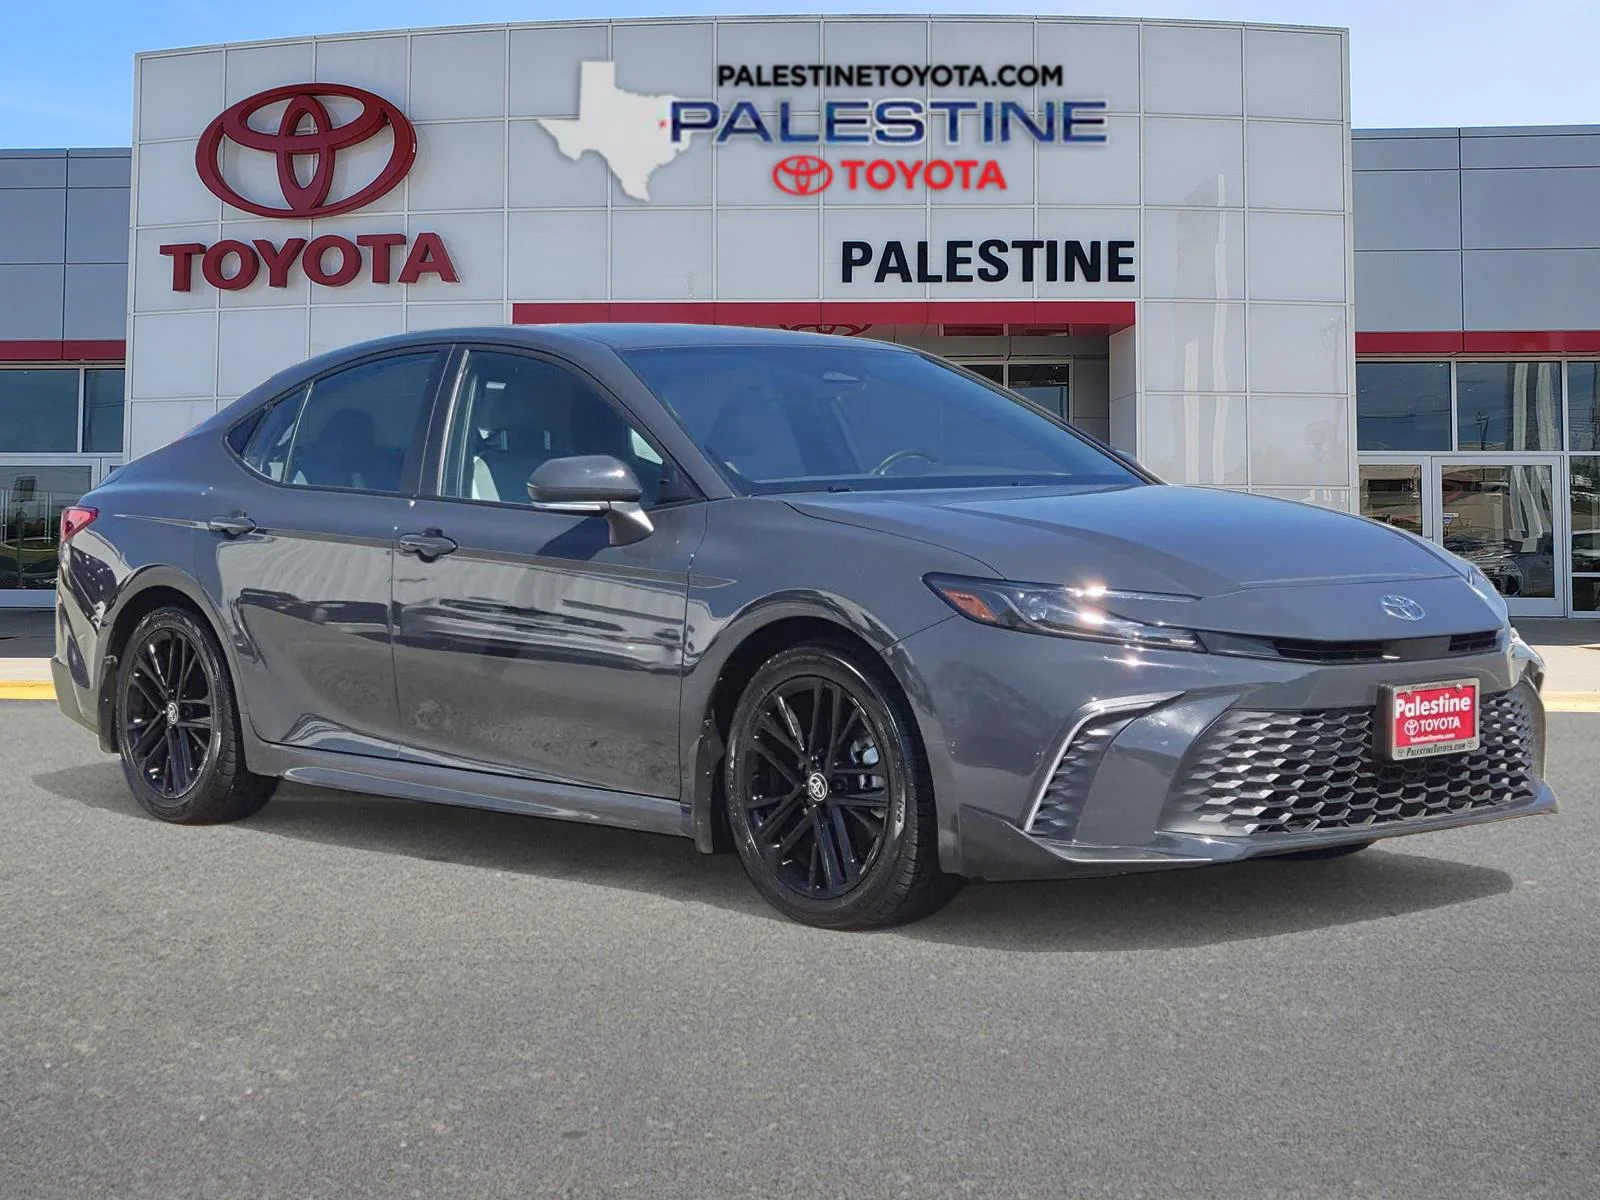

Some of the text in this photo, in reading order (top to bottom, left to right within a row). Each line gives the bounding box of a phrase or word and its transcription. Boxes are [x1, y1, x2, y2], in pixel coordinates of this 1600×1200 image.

[159, 232, 461, 293] TOYOTA
[840, 240, 1136, 284] PALESTINE
[1395, 693, 1471, 719] Palestine
[1419, 716, 1461, 732] TOYOTA
